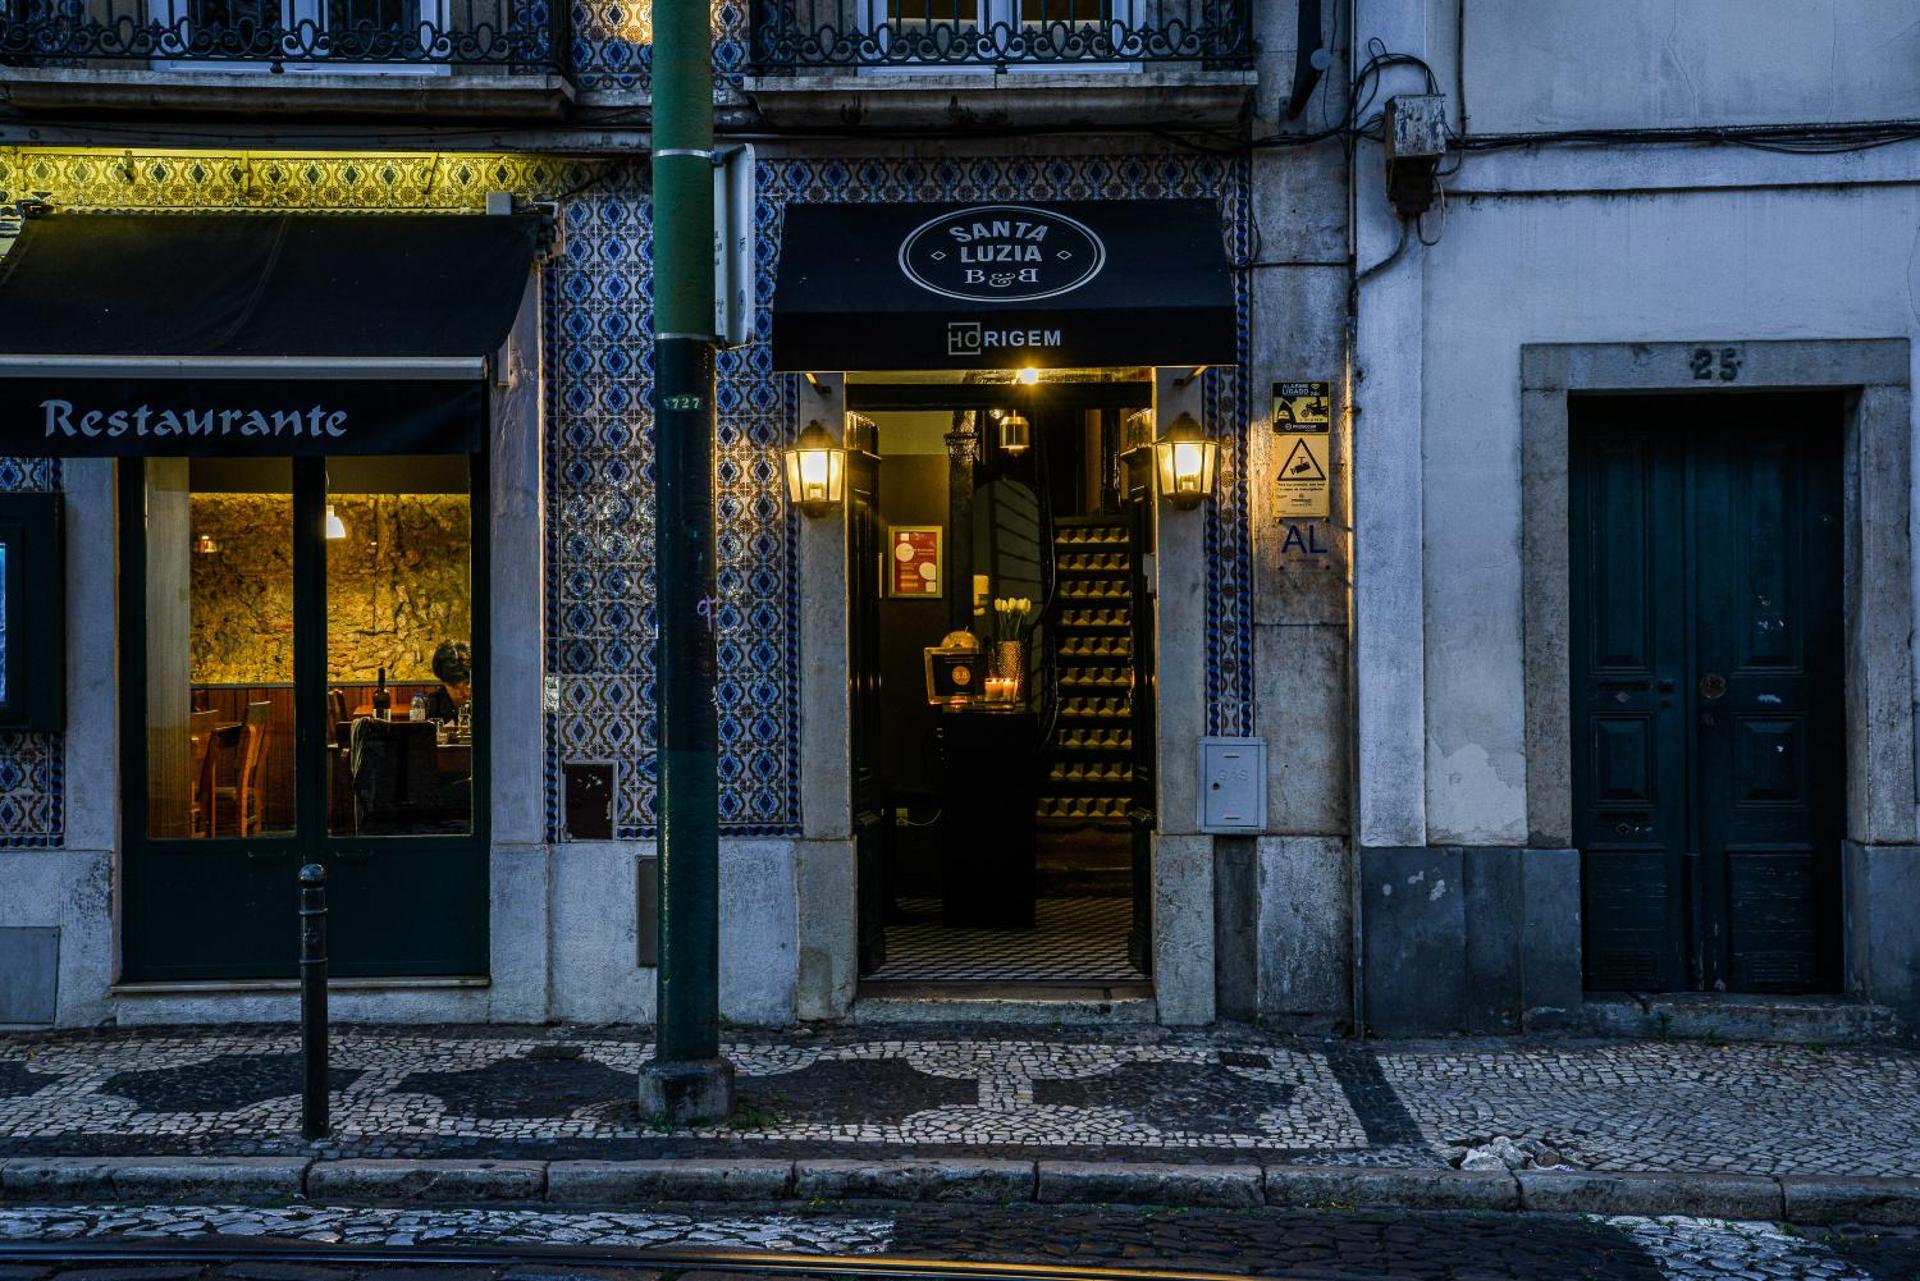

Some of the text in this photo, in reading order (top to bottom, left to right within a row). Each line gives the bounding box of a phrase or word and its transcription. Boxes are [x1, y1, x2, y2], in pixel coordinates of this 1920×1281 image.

[949, 220, 1048, 243] SANTA
[960, 245, 1042, 263] LUZIA
[964, 268, 1039, 287] B&B
[1694, 348, 1737, 381] 25
[39, 399, 348, 438] Restaurante
[1281, 525, 1328, 553] AL
